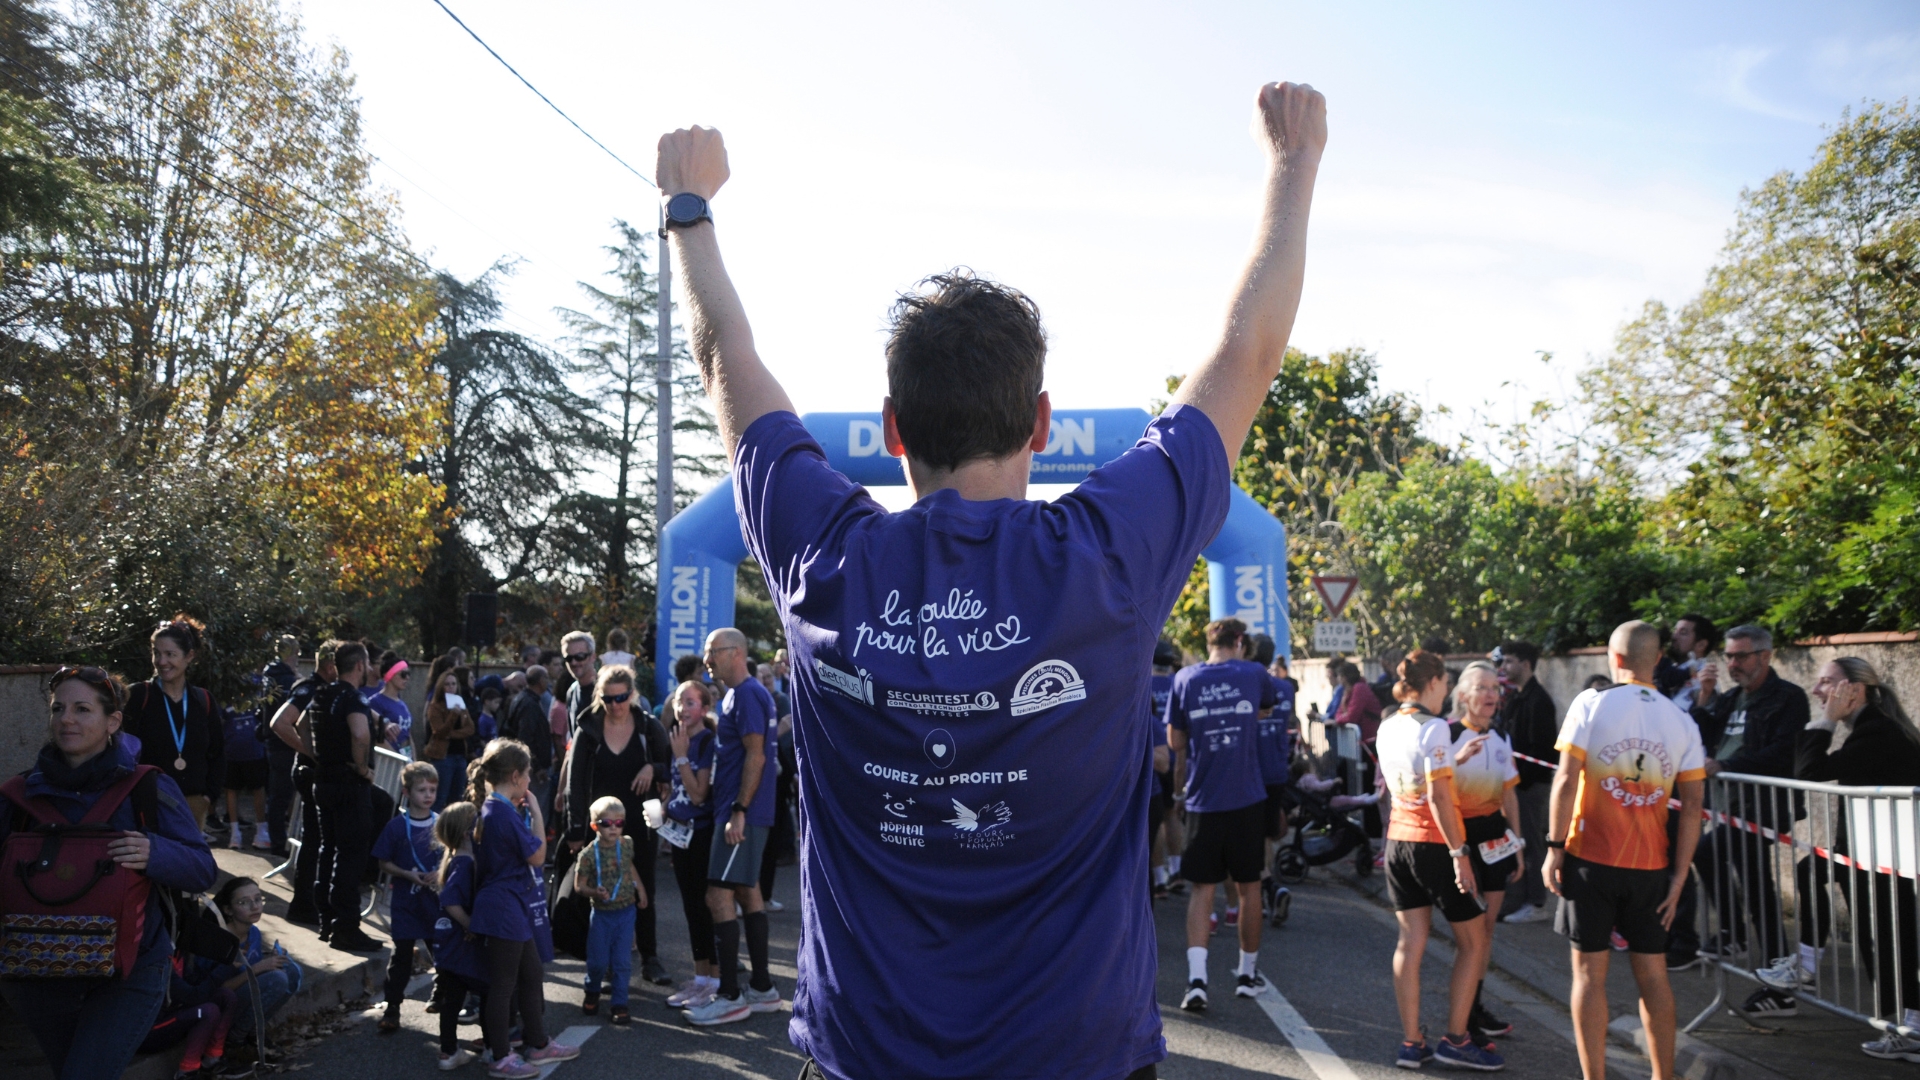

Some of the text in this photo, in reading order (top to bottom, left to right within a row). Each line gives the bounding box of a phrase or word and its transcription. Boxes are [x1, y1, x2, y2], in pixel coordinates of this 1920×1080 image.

[879, 588, 987, 637] la oulée
[1320, 625, 1352, 635] STOP
[853, 621, 916, 657] pour
[923, 626, 949, 658] la
[1319, 637, 1337, 647] 150
[887, 690, 970, 704] SECURITEST
[929, 703, 972, 711] TECHNIQUE
[917, 709, 970, 717] SEYSSES
[863, 762, 1028, 786] COUREZ AU PROFIT DE
[952, 829, 1005, 840] SECOURS
